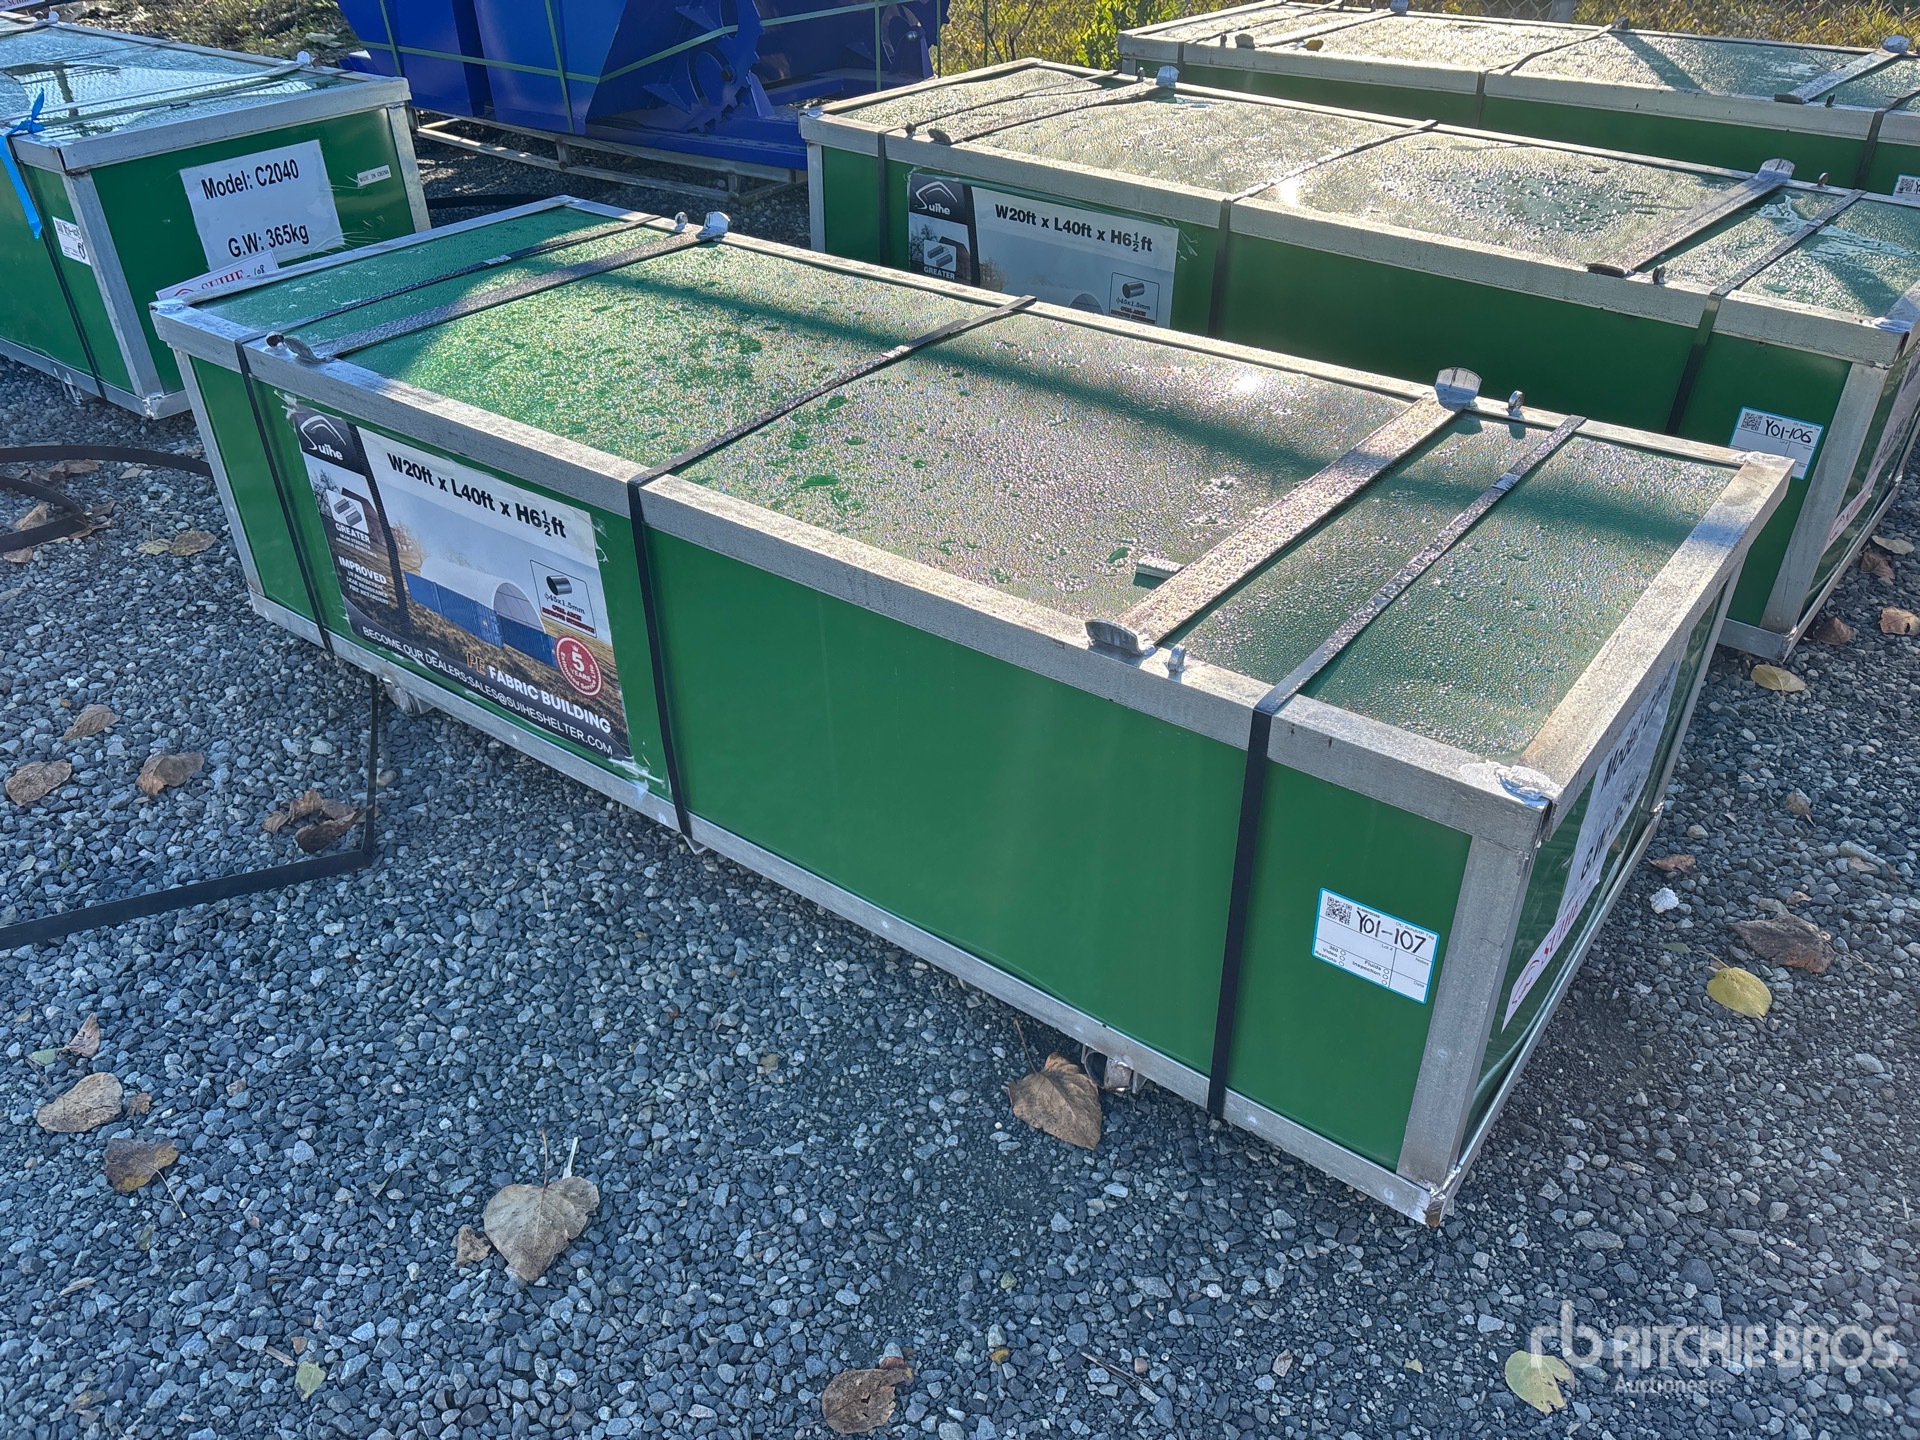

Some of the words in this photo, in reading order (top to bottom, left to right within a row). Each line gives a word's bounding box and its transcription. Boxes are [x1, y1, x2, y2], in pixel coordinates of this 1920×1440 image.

[201, 170, 253, 200] Model:
[255, 158, 299, 187] C2040
[995, 203, 1037, 226] W20ft
[1040, 216, 1050, 229] x
[1054, 218, 1092, 239] L40ft
[1096, 229, 1106, 242] x
[228, 232, 265, 258] G.W:
[266, 223, 310, 248] 365kg
[923, 265, 956, 280] GREATER
[387, 452, 434, 487] W20ft
[437, 476, 448, 493] x
[451, 478, 495, 512] L40ft
[500, 499, 512, 517] x
[335, 522, 370, 544] GREATER
[338, 556, 387, 584] IMPROVED
[362, 626, 402, 651] BECOME
[402, 644, 424, 661] OUR
[570, 668, 592, 682] YEARS
[572, 651, 585, 672] 5
[488, 665, 539, 700] FABRIC
[540, 690, 612, 734] BUILDING
